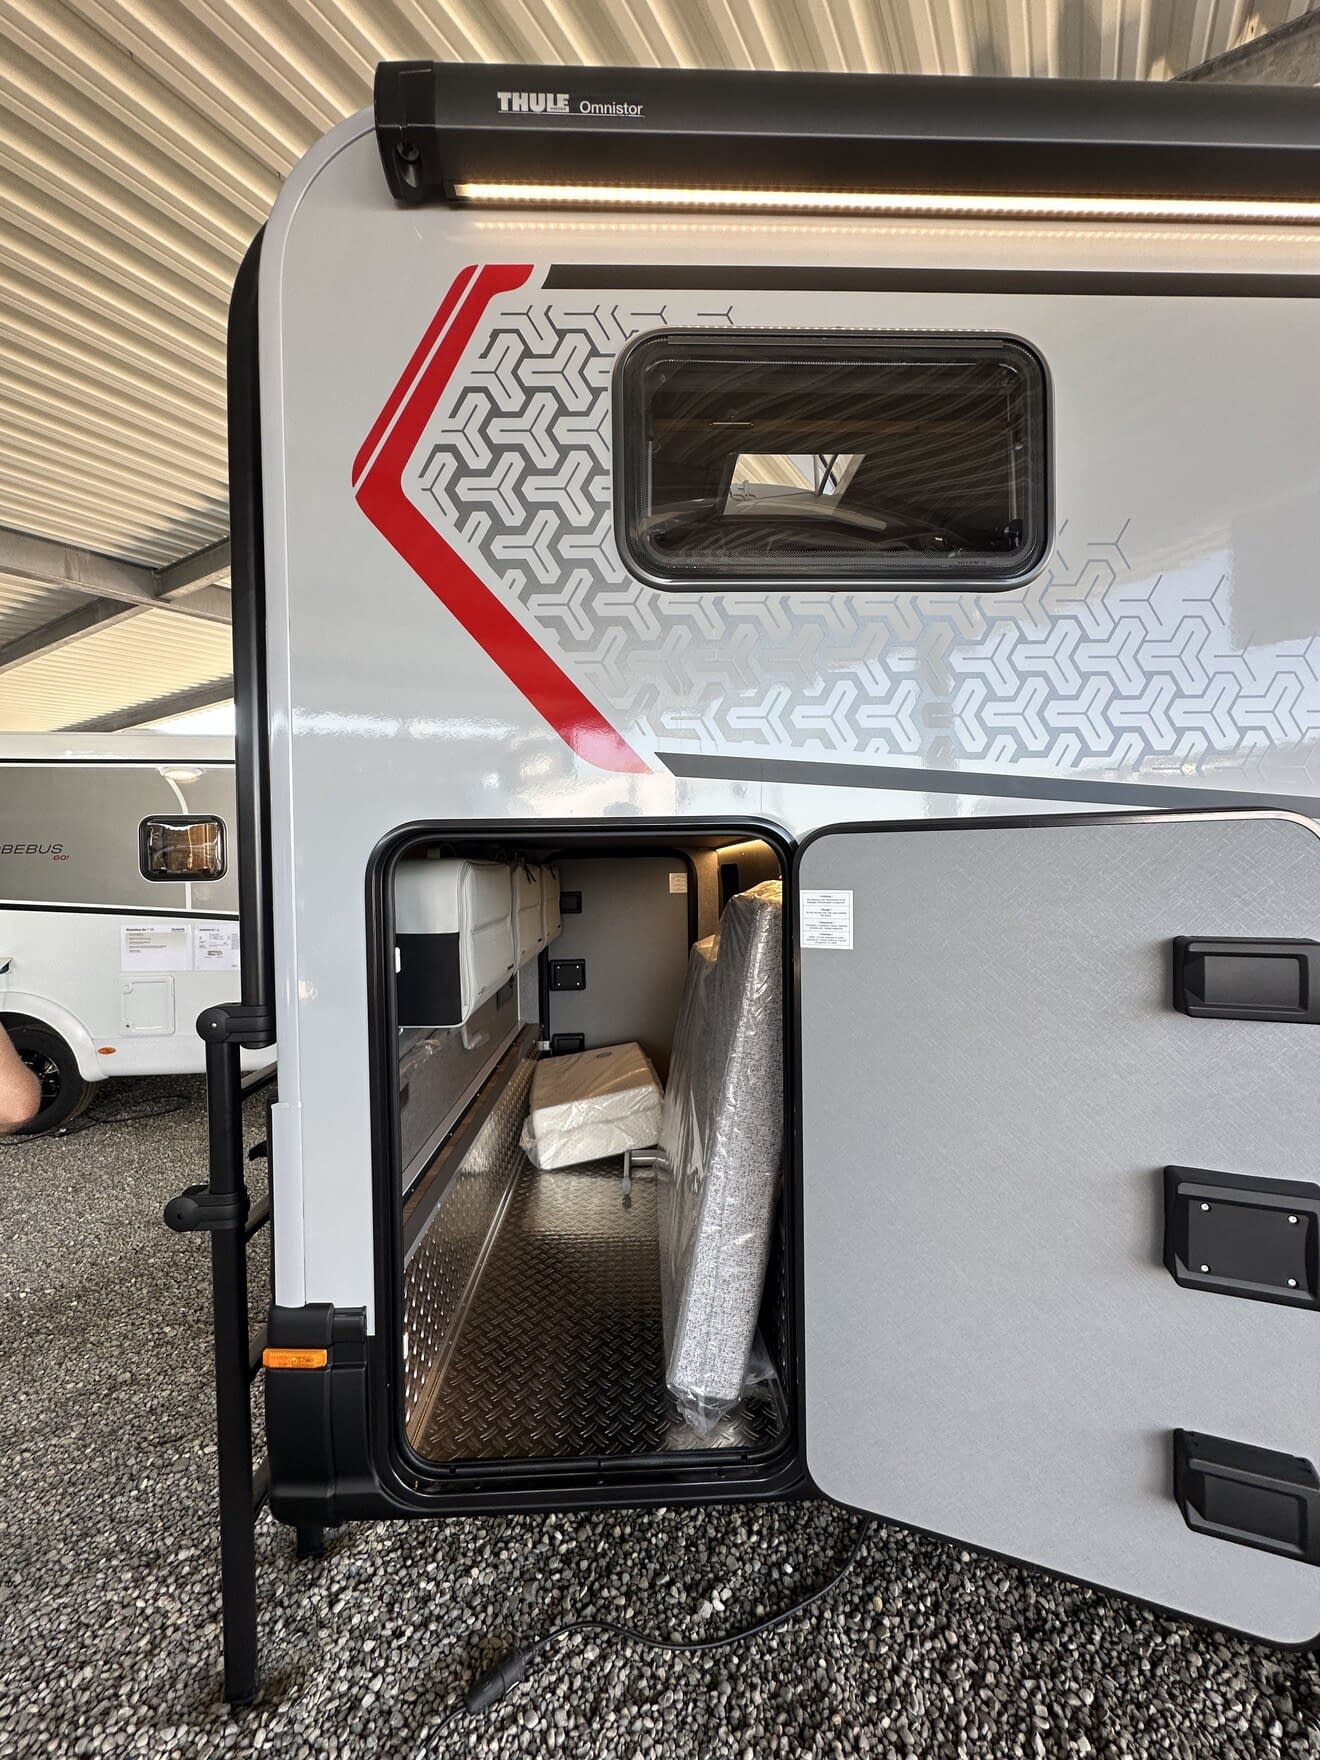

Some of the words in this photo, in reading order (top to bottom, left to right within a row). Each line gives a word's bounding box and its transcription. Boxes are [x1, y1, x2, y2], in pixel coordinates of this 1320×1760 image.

[497, 92, 570, 113] THULE
[579, 101, 643, 115] Omnistor
[0, 844, 63, 854] BEBUS
